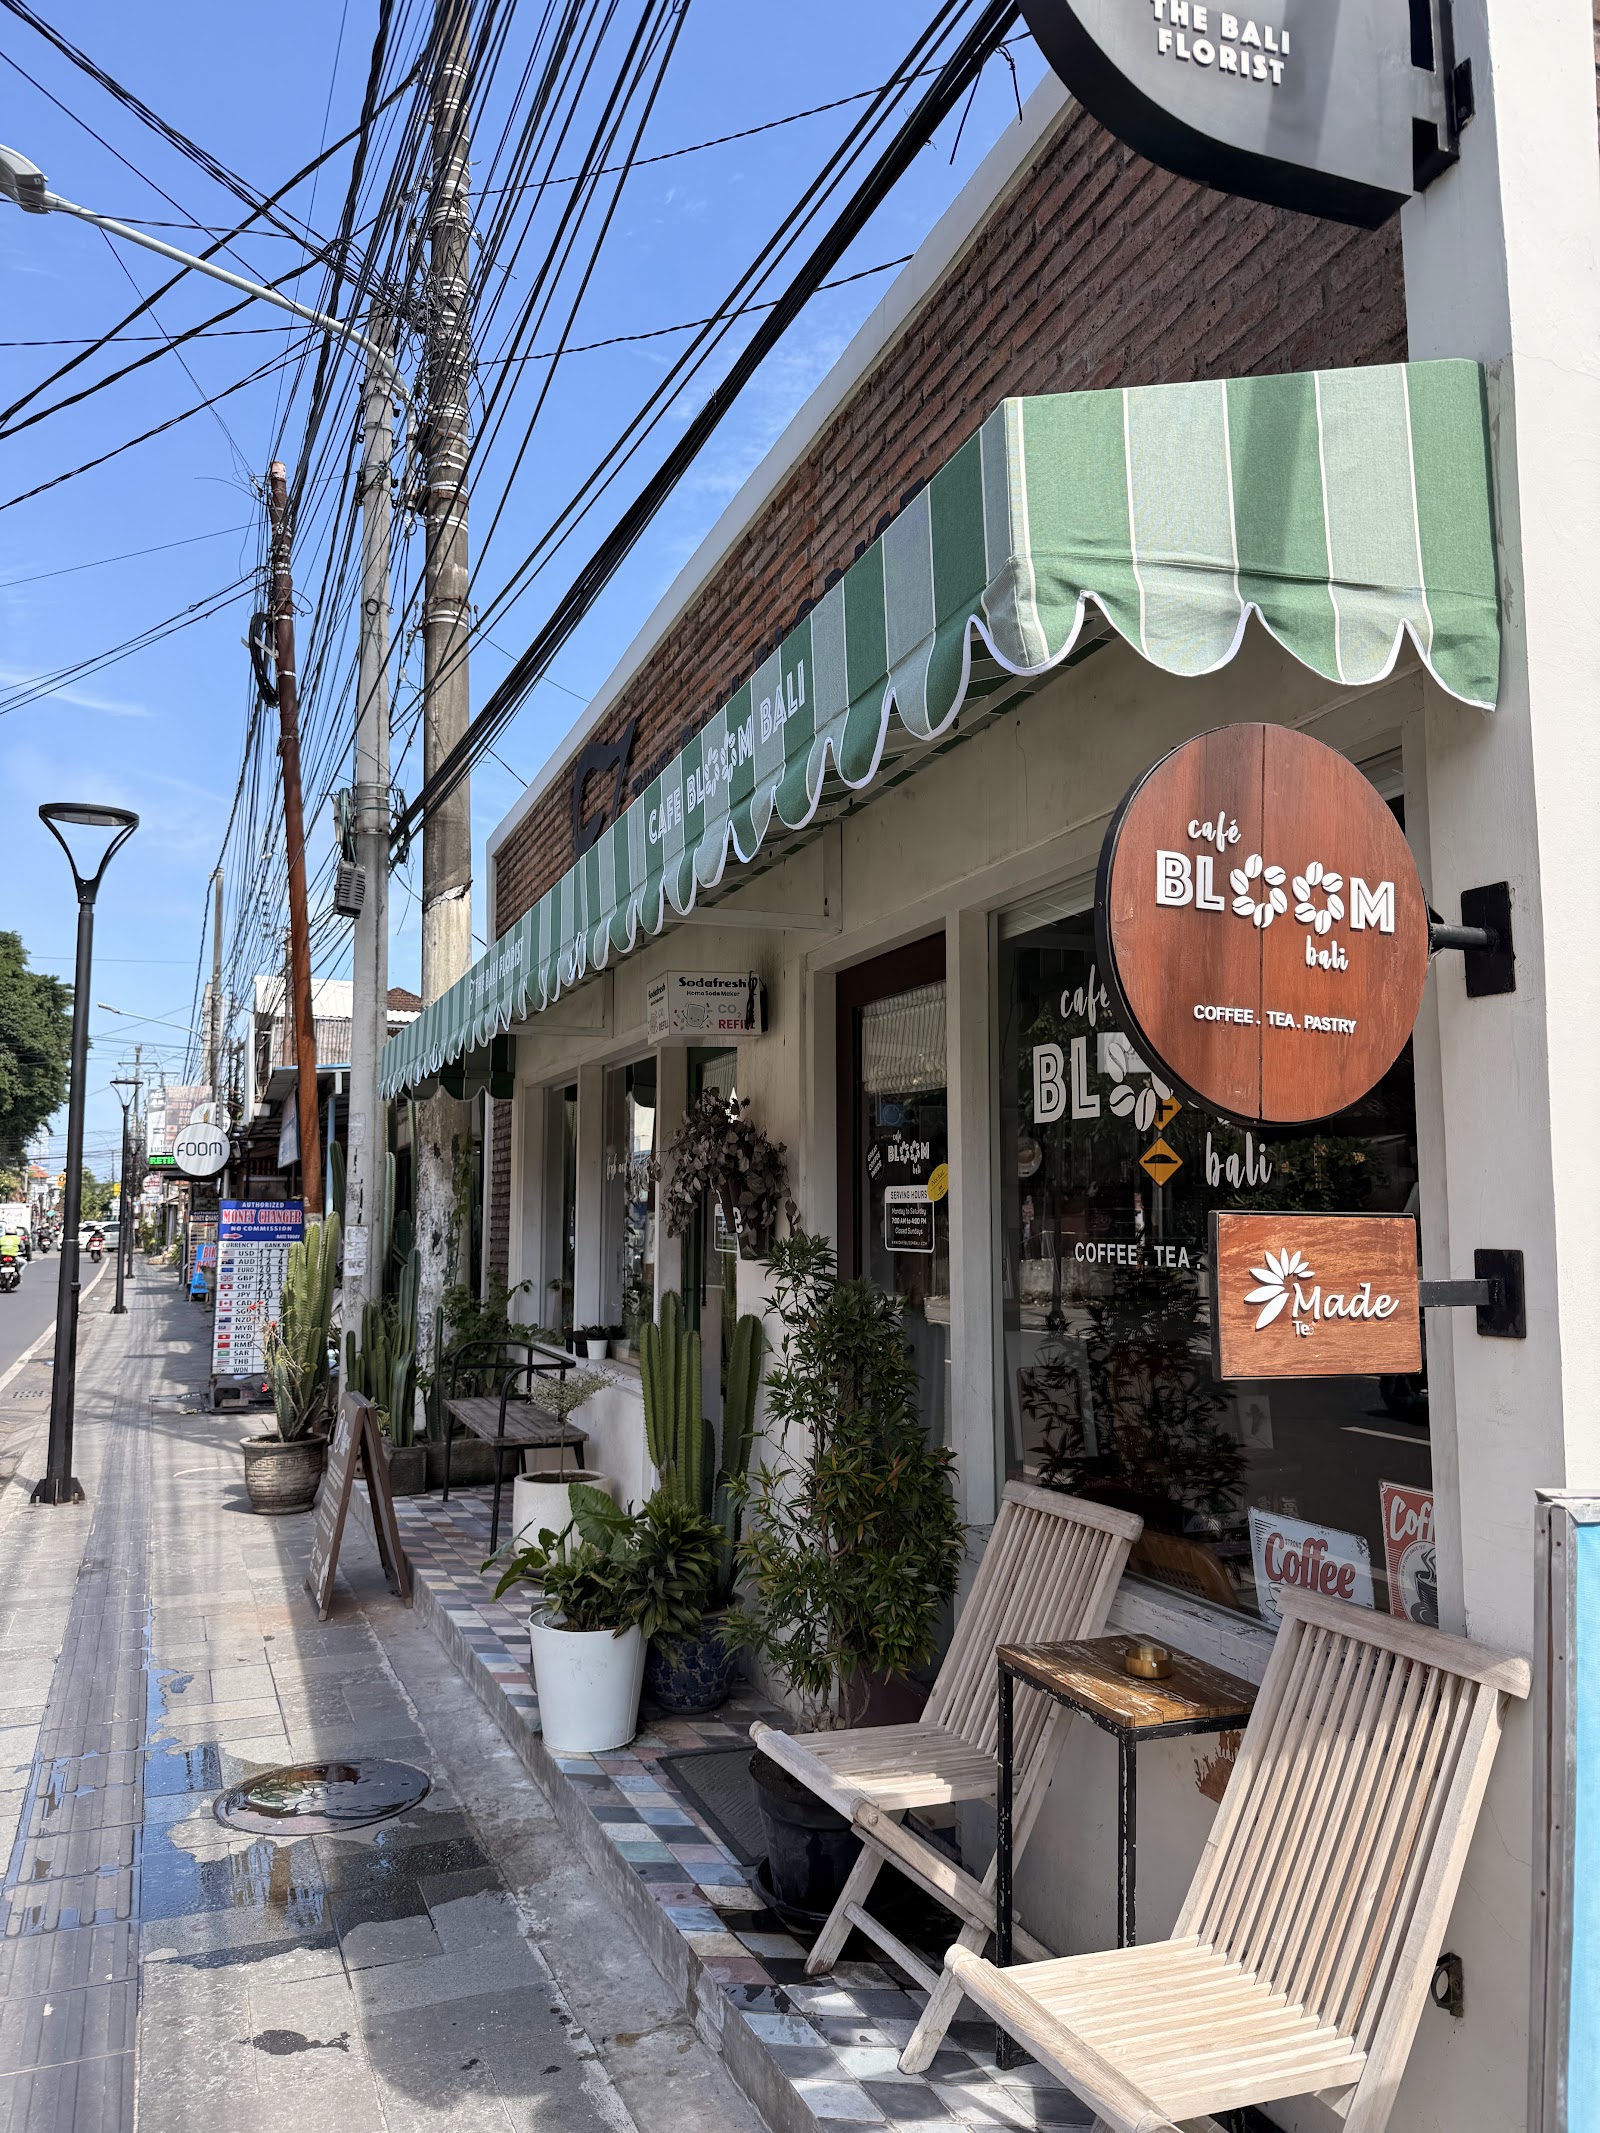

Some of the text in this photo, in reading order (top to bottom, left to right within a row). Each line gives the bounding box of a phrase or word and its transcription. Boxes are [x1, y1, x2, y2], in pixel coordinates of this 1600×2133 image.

[1150, 0, 1290, 55] THE BALI
[1158, 27, 1285, 84] FLORIST
[648, 786, 682, 845] CAFE
[686, 714, 754, 814] BLOOM
[759, 659, 806, 744] BALI
[1187, 810, 1242, 852] café
[1155, 849, 1395, 936] BLOOM
[1305, 934, 1349, 971] bali
[475, 935, 525, 1000] THE BALI FLORIST
[678, 976, 747, 988] Sodafresh
[1266, 1010, 1295, 1028] TEA
[1303, 1014, 1358, 1034] PASTRY
[176, 1141, 223, 1157] FOOM
[887, 1140, 930, 1165] BLOOM
[1205, 1131, 1273, 1189] bali
[241, 1201, 285, 1209] AUTHORIZED
[890, 1190, 928, 1200] SERVING HOURS
[222, 1208, 302, 1225] MONEY CHANGER
[891, 1207, 905, 1216] Monday
[910, 1207, 927, 1216] Saturday
[920, 1217, 927, 1225] PM
[894, 1226, 924, 1237] Closed Sundays
[1074, 1241, 1190, 1269] COFFEE TEA
[1292, 1282, 1400, 1320] Made
[1264, 1532, 1356, 1599] Coffee
